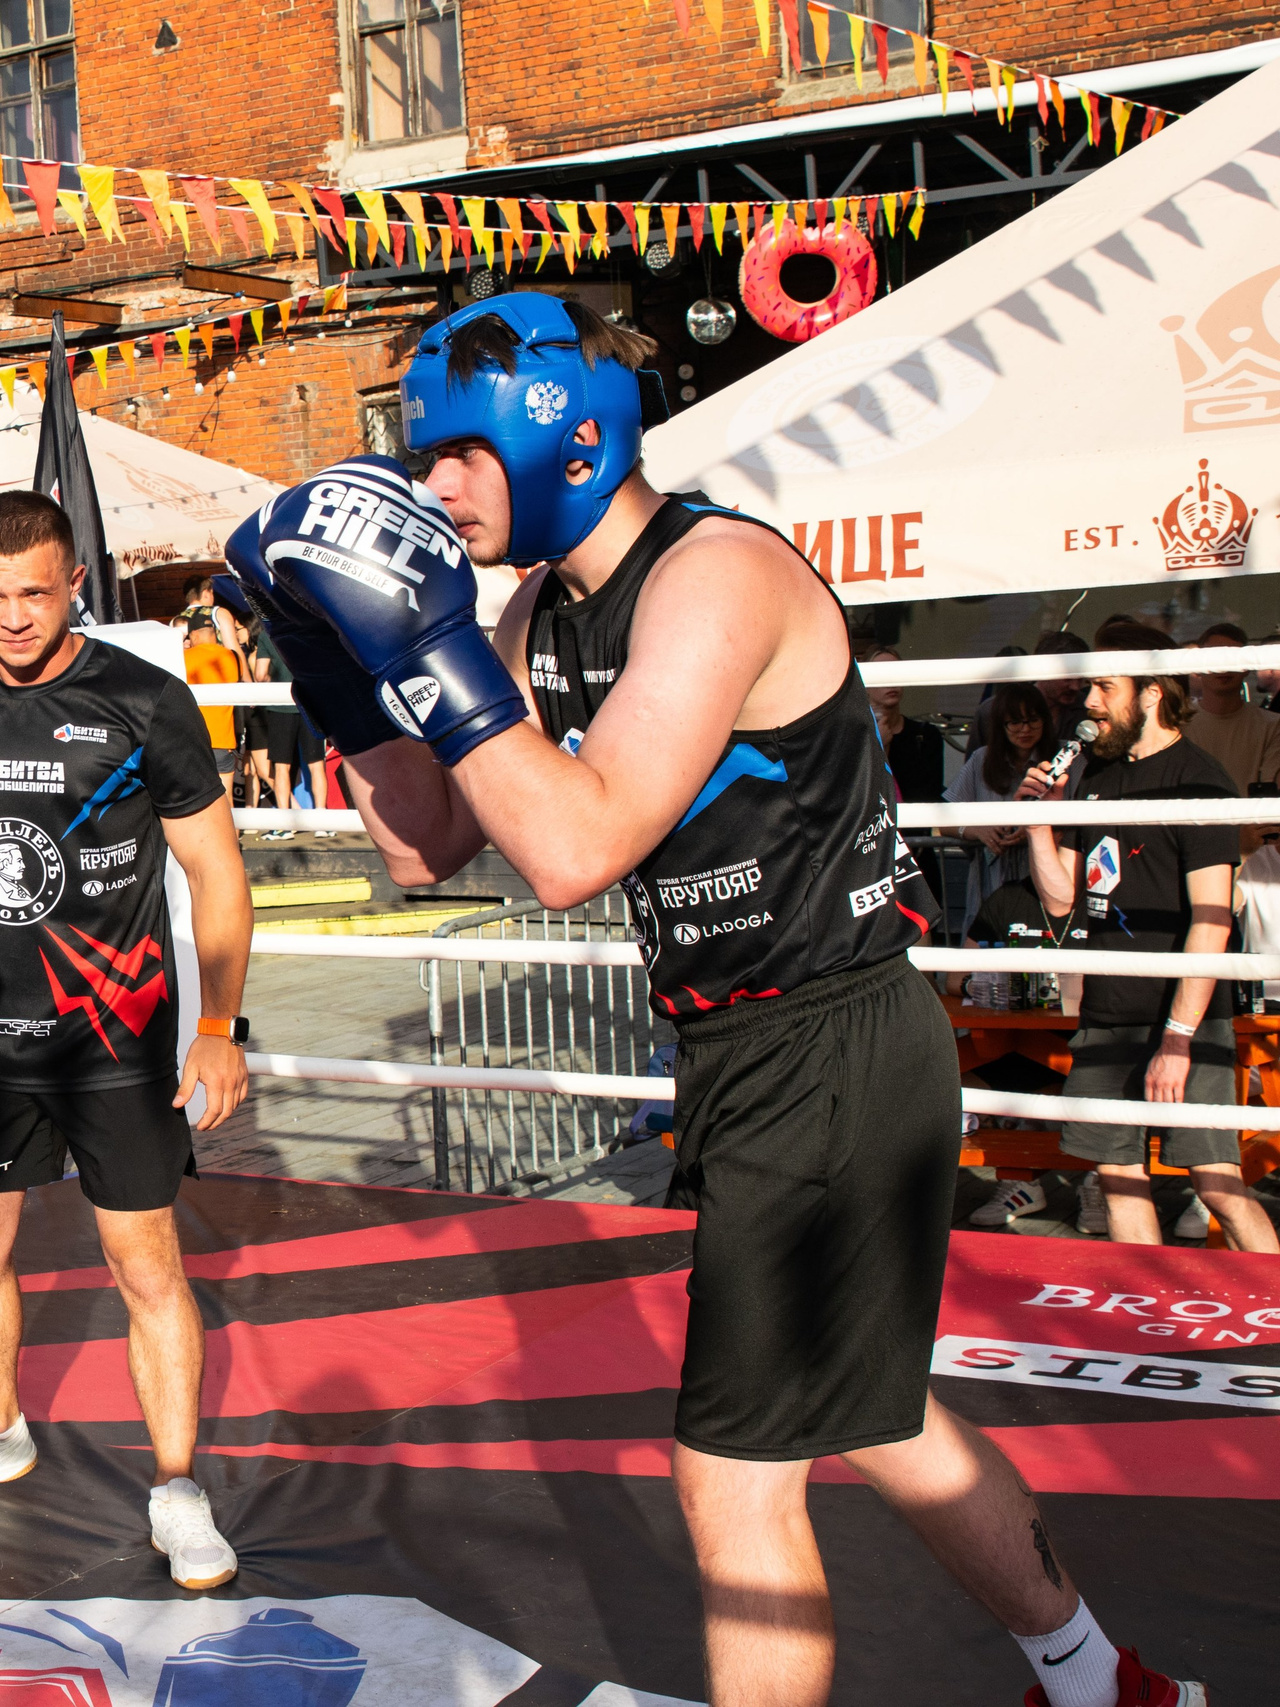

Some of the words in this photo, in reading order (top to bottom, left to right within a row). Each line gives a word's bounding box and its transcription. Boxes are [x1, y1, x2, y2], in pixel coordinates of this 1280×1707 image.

[308, 481, 462, 569] GREEN
[1063, 524, 1140, 552] EST.
[297, 503, 426, 584] HILL
[302, 545, 316, 558] BE
[315, 549, 341, 570] YOUR
[341, 559, 366, 579] BEST
[364, 569, 388, 589] SELF
[406, 679, 436, 703] GREEN
[410, 688, 435, 708] HILL
[74, 725, 108, 739] БИТВА
[80, 843, 138, 871] КРУТОЯР
[862, 840, 877, 855] GIN
[680, 870, 713, 884] РУССКАЯ
[713, 857, 758, 877] ВИНОКУРНЯ
[658, 866, 763, 909] КРУТОЯР
[702, 911, 774, 938] LADOGA
[1137, 1323, 1260, 1344] GIN
